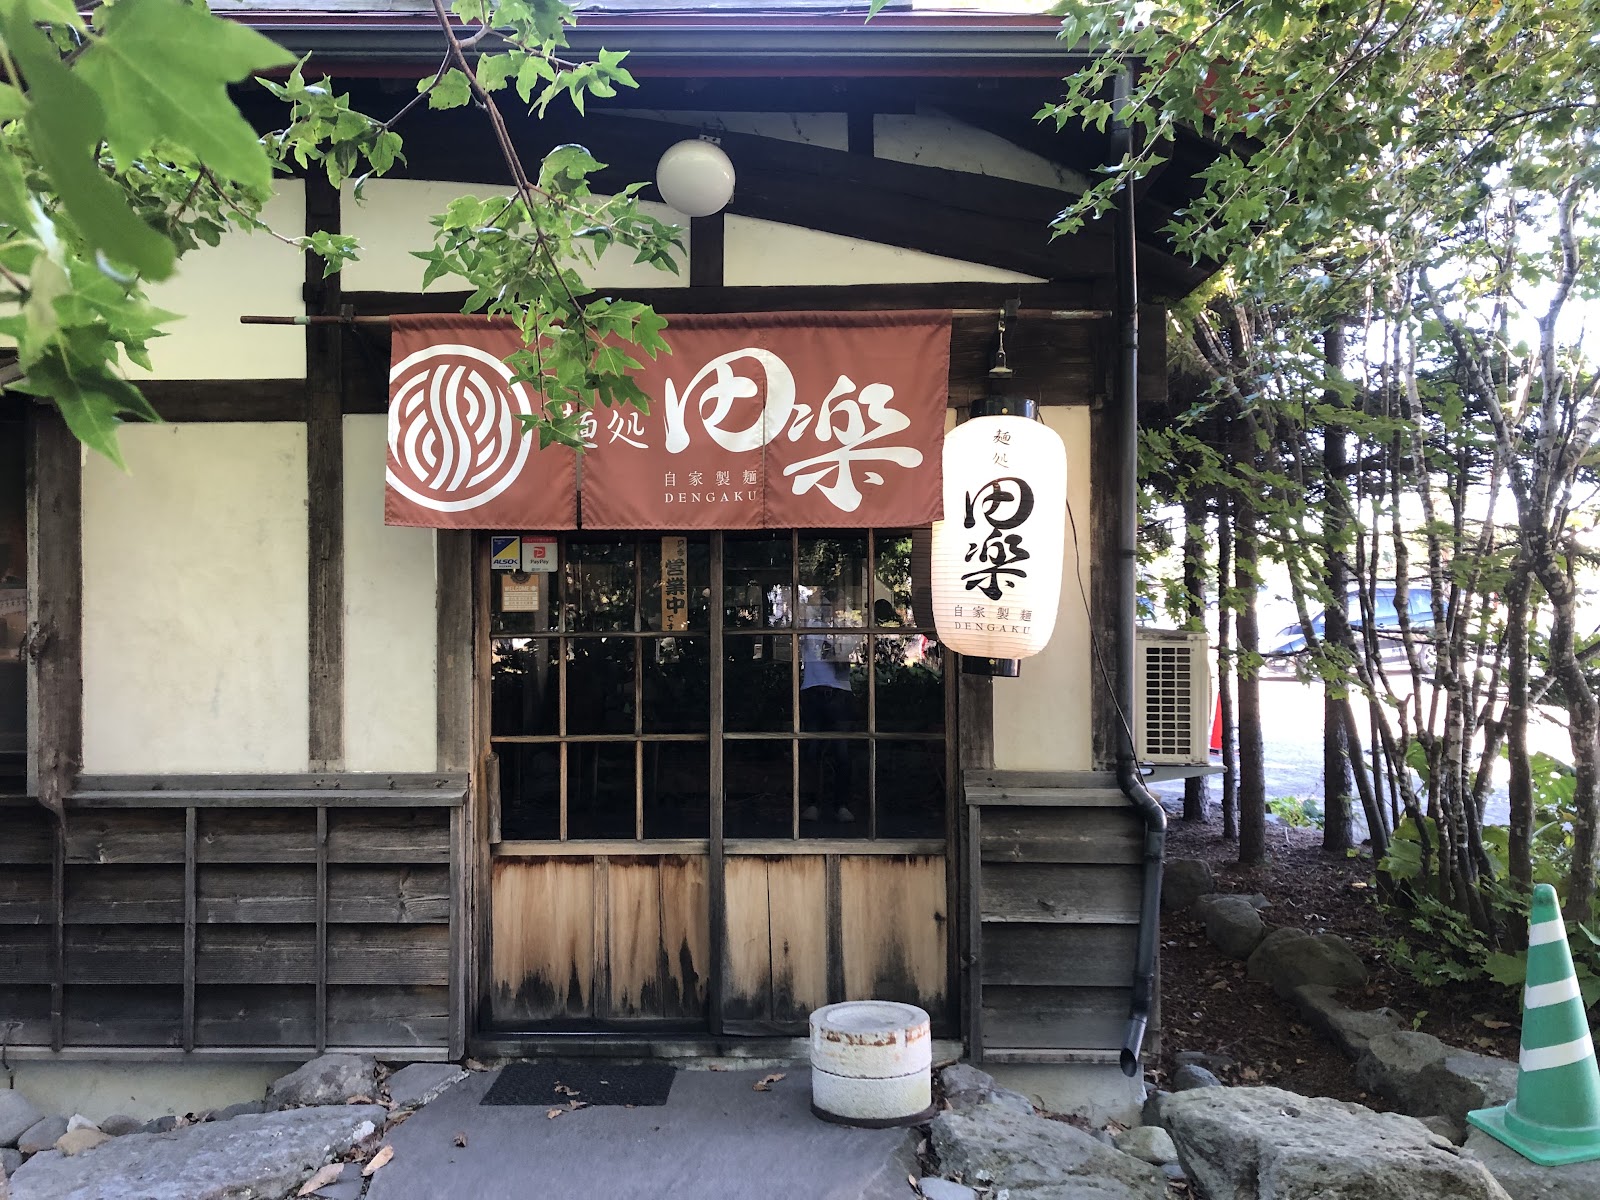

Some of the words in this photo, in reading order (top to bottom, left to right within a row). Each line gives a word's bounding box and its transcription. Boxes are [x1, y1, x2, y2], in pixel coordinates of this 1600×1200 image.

[664, 347, 923, 512] 田楽
[992, 429, 1011, 469] 麺処
[665, 470, 758, 487] 自家製麺
[665, 490, 757, 503] DENGAKU
[960, 476, 1035, 601] 田楽
[954, 604, 1032, 622] 自家製麺
[954, 621, 1031, 635] DENGAKU
